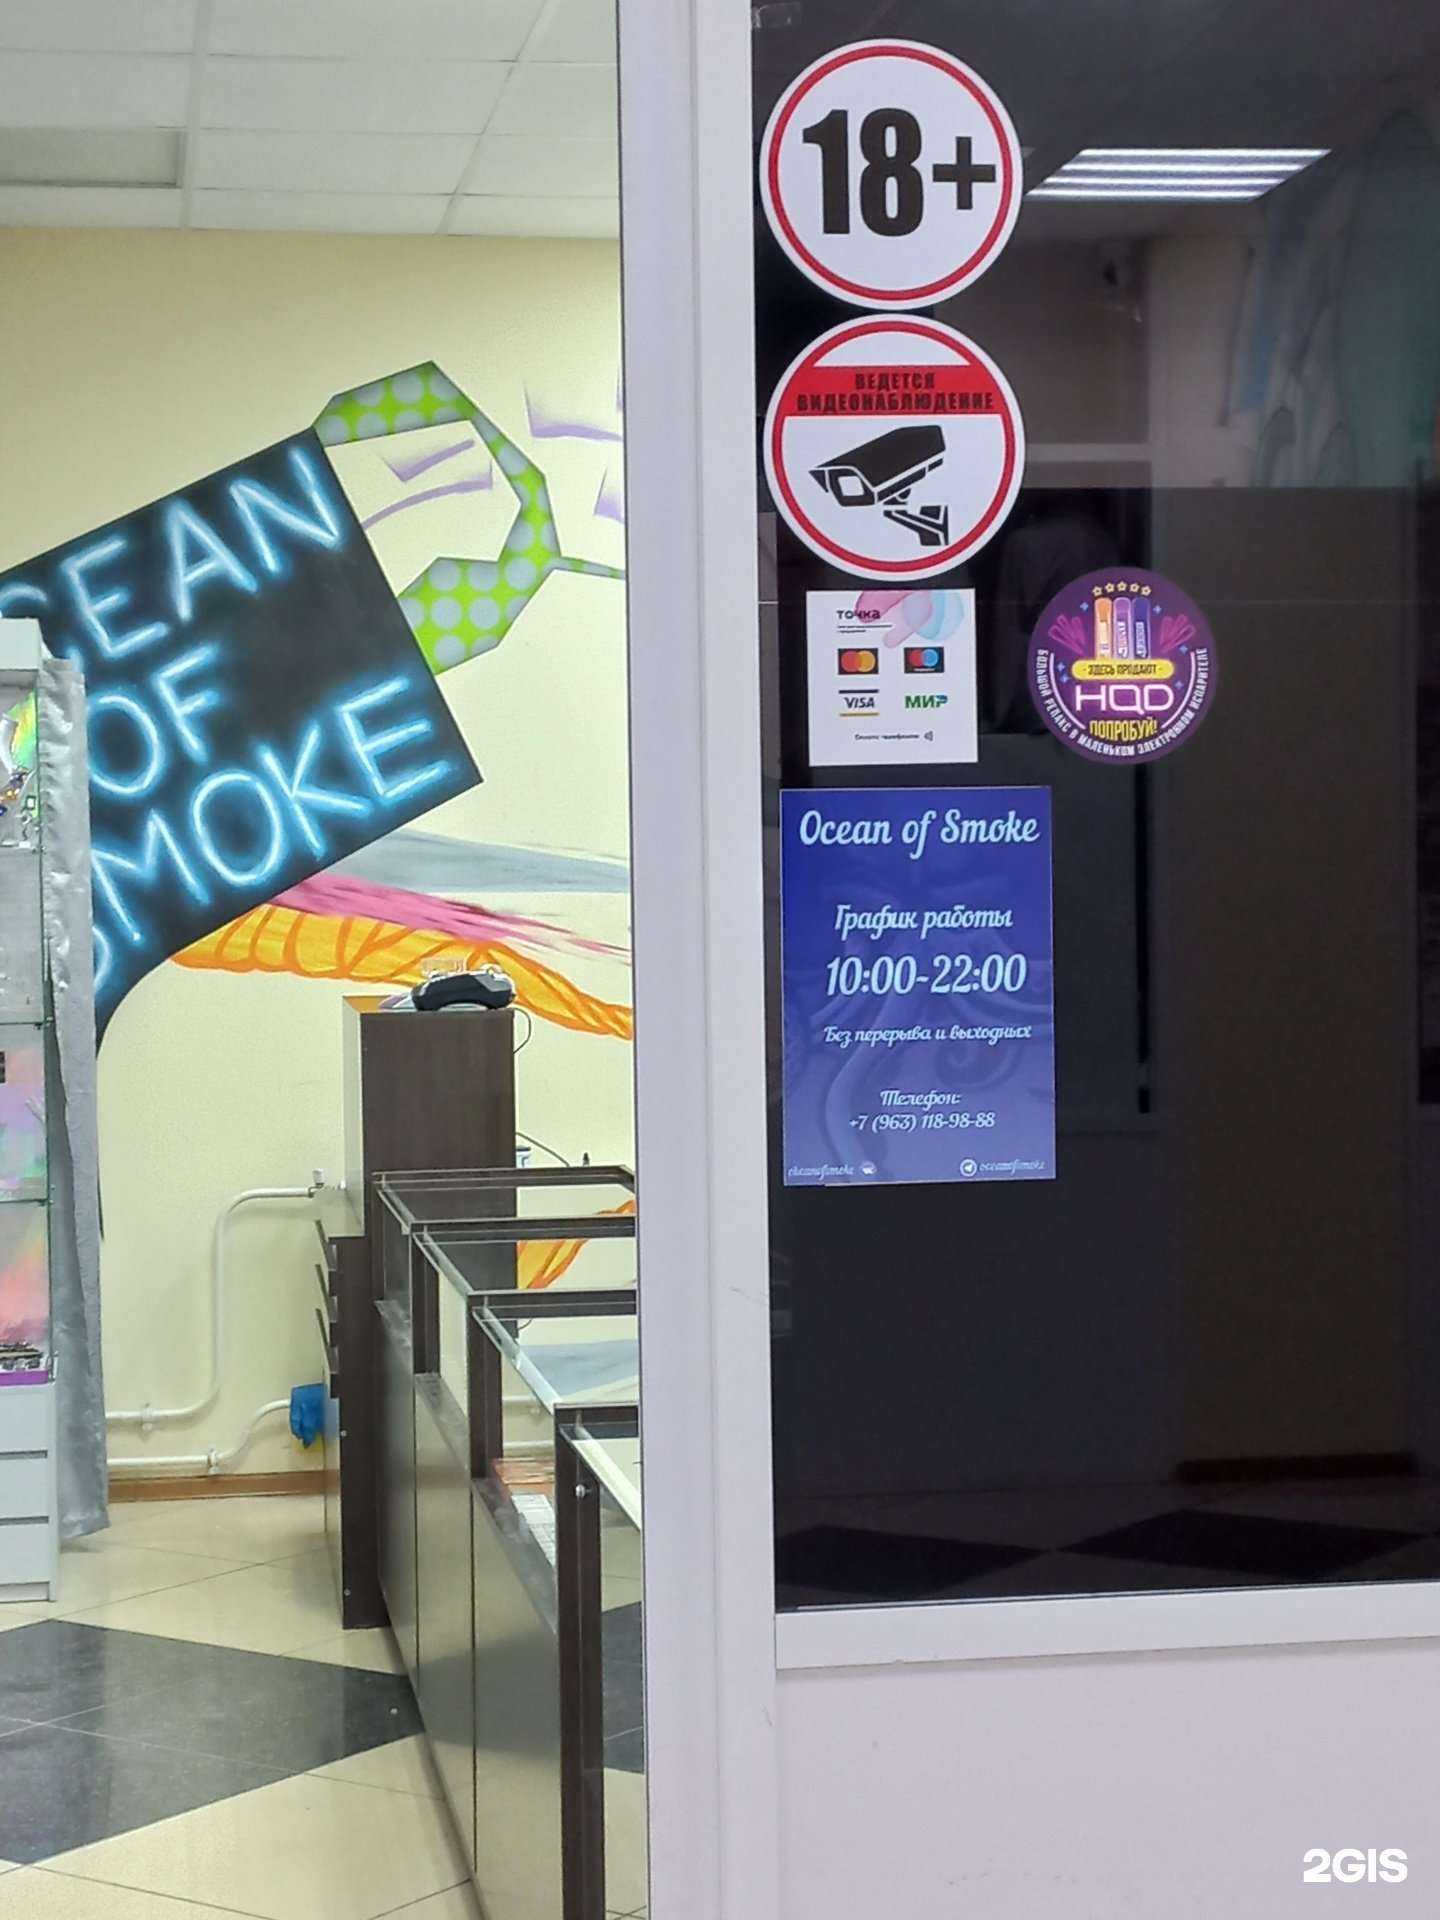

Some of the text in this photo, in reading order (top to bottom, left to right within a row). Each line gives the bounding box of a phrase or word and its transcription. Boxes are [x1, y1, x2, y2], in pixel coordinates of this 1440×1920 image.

[802, 107, 996, 237] 18+
[855, 372, 935, 391] ВЕДЕТСЯ
[796, 392, 994, 413] ВИДЕОНАБЛЮДЕНИЕ
[836, 609, 881, 620] точка
[1036, 649, 1053, 697] БОЛЬШОЙ
[1088, 663, 1157, 676] ЗДЕСЬ ПРОДАЮТ
[844, 696, 875, 709] VISA
[905, 695, 948, 709] МИР
[1075, 684, 1174, 715] HQD
[86, 644, 220, 796] OF
[1043, 697, 1072, 733] РЕЛАКС
[1068, 729, 1079, 740] В
[1089, 716, 1158, 742] ПОПРОБУЙ!
[1077, 733, 1135, 756] МАЛЕНЬКОМ
[799, 808, 1040, 860] Ocean of Smoke
[834, 904, 1013, 940] График работы
[825, 953, 1027, 996] 10:00-22:00
[824, 1025, 1032, 1048] Без перерыва и выходных
[880, 1090, 962, 1111] Телефон:
[849, 1112, 996, 1132] +7 (963) 118-98-88
